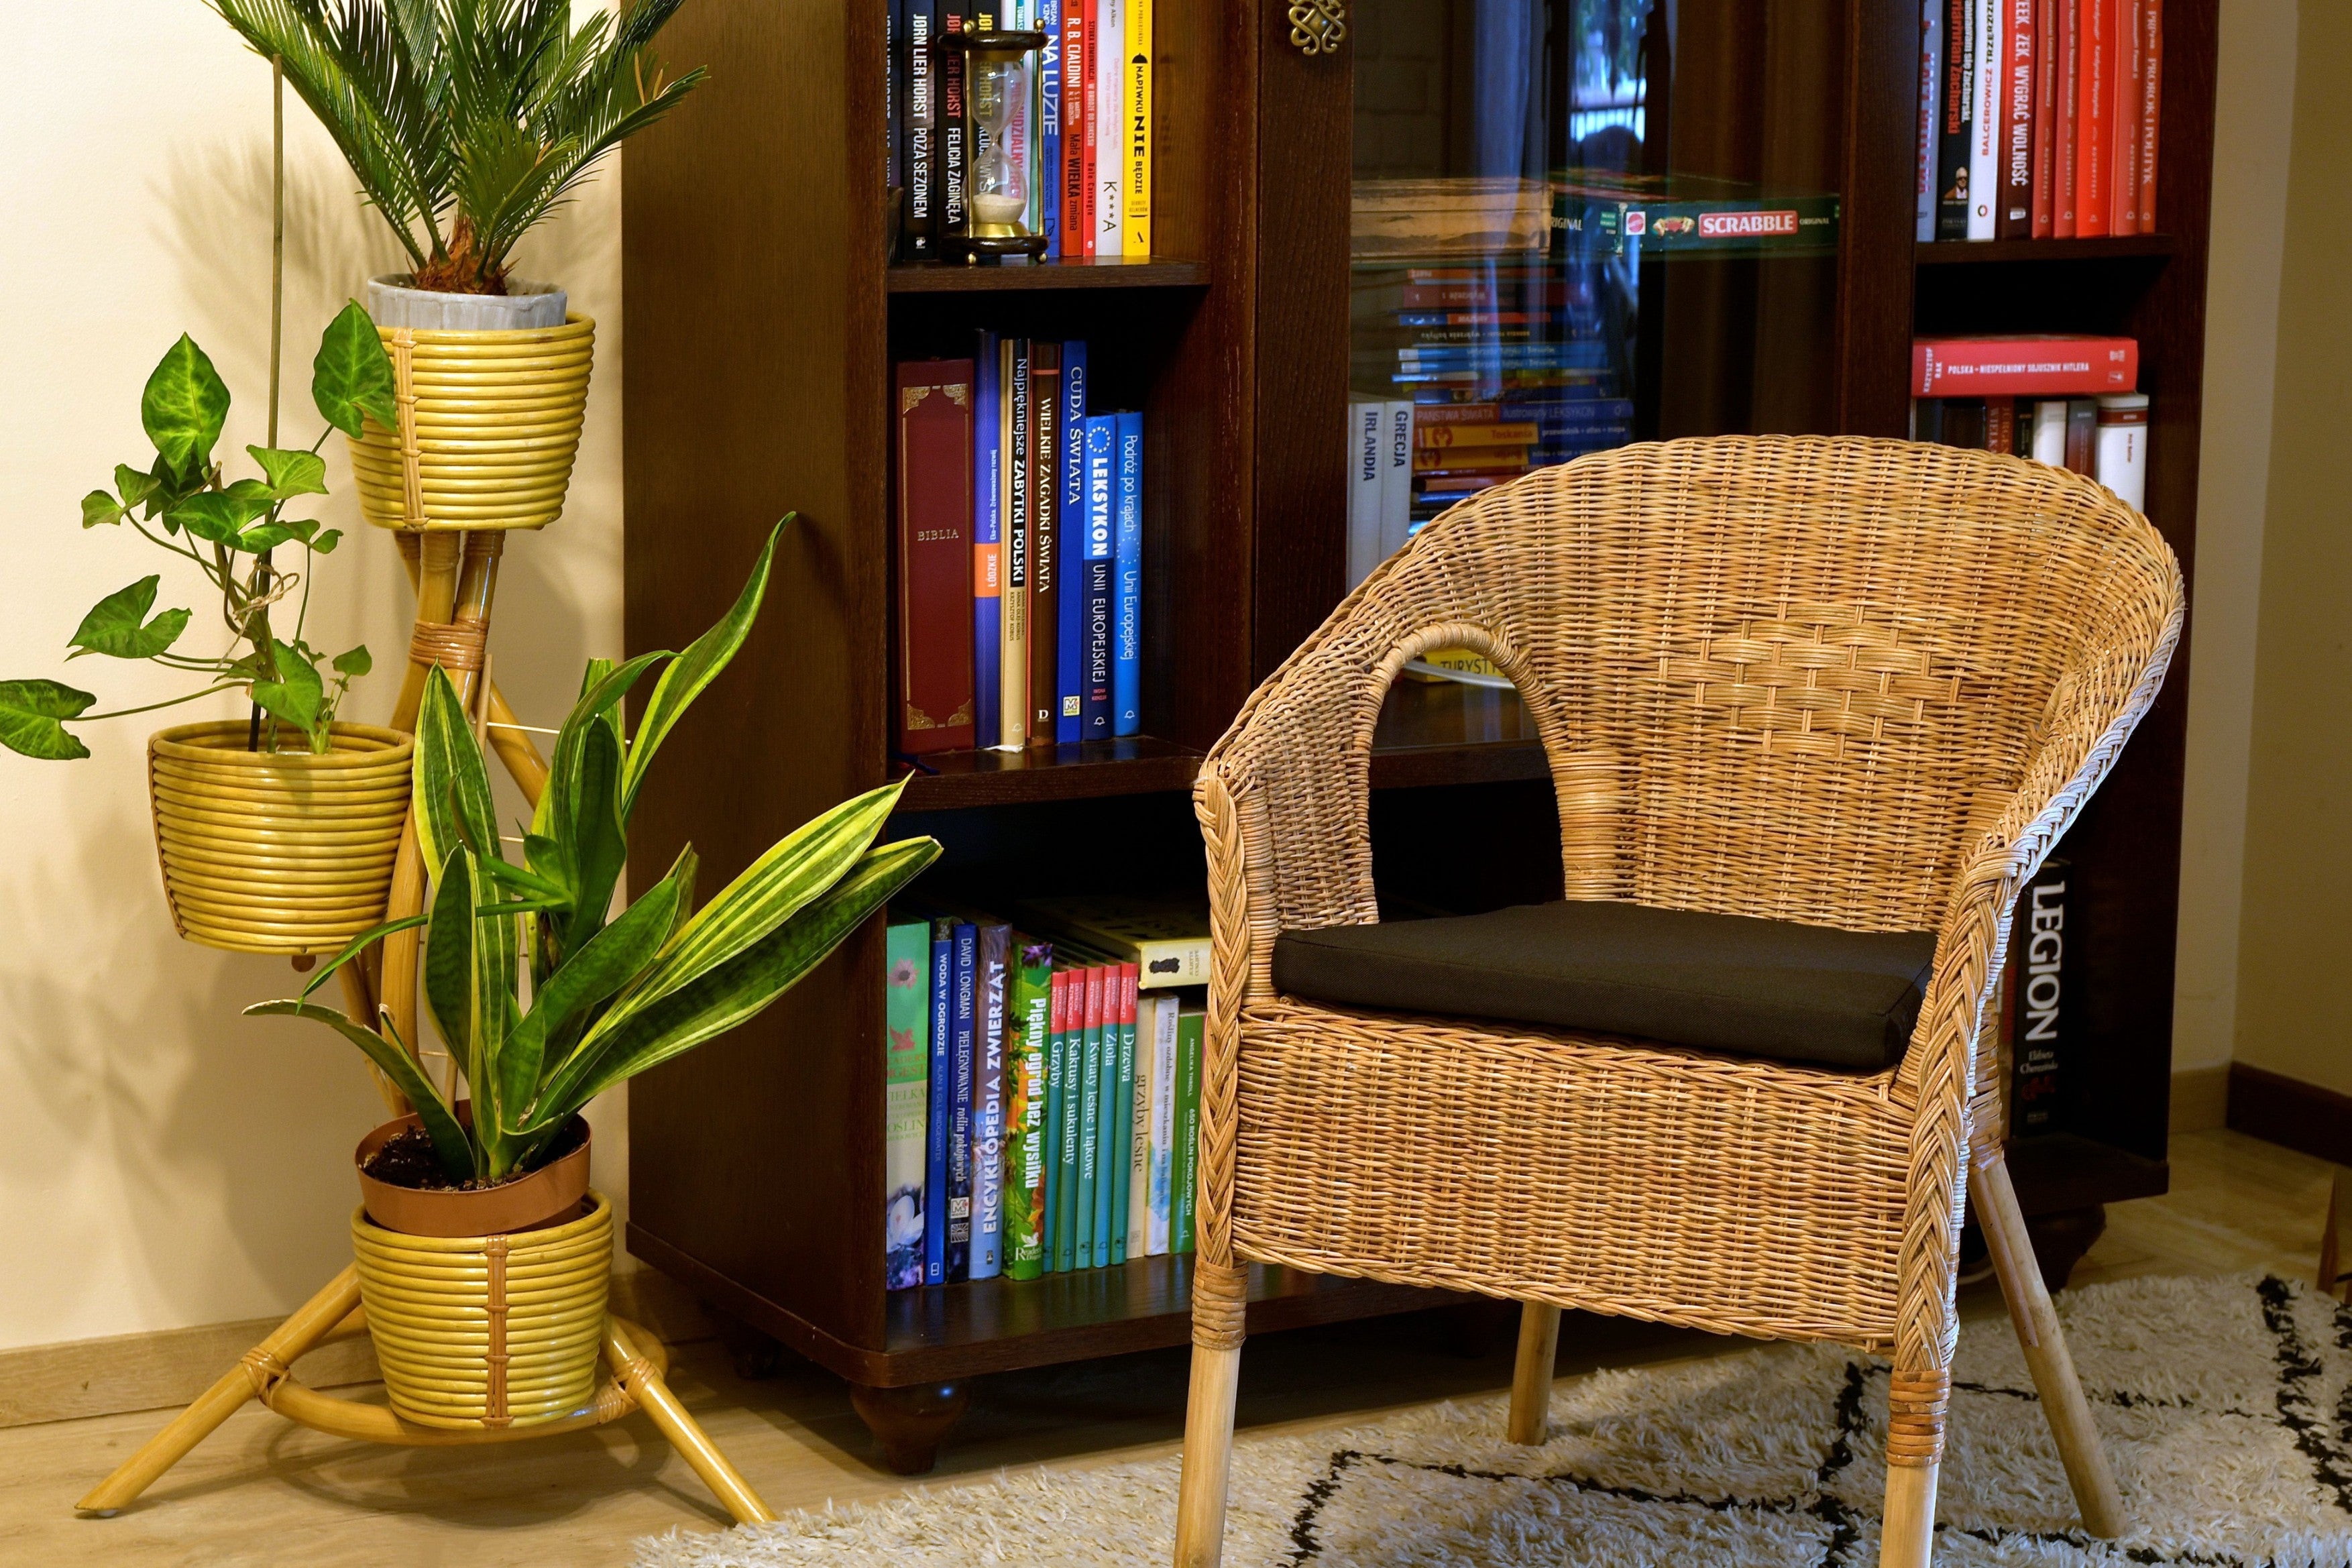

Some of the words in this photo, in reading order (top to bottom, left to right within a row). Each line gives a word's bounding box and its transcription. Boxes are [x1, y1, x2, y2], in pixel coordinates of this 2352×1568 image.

[913, 14, 928, 45] JØRN
[1067, 17, 1081, 28] R.
[1067, 31, 1081, 41] B.
[913, 48, 928, 75] LIER
[1042, 35, 1058, 66] NA
[1067, 44, 1081, 88] CIALDINI
[913, 78, 928, 119] HORST
[947, 78, 961, 118] HORST
[978, 77, 993, 117] HORST
[1042, 70, 1058, 136] LUZIE
[1135, 66, 1143, 113] NAPIWKU
[1948, 66, 1964, 135] Zacharski
[2013, 64, 2031, 120] WYGRAĆ
[2145, 58, 2157, 114] PROROK
[1982, 68, 1993, 156] BALCEROWICZ
[913, 128, 928, 160] POZA
[947, 127, 961, 168] FELICIA
[1069, 134, 1081, 155] Mała
[1134, 115, 1145, 157] NIE
[2011, 123, 2030, 186] WOLNOŚĆ
[2143, 126, 2155, 184] POLITYK
[913, 162, 928, 218] SEZONEM
[945, 170, 962, 223] ZAGINĘŁA
[1068, 158, 1081, 198] WIELKA
[1133, 161, 1143, 194] BĘDZIE
[1067, 200, 1079, 231] zmiana
[1552, 217, 1583, 231] RIGINAL
[1703, 215, 1793, 233] SCRABBLE
[1948, 364, 1974, 375] POLSKA
[2062, 362, 2089, 372] HITLERA
[1013, 358, 1027, 455] Najpiękniejsze
[1070, 366, 1083, 423] CUDA
[1040, 397, 1052, 460] WIELKIE
[1363, 412, 1378, 481] IRLANDIA
[1394, 411, 1408, 468] GRECJA
[1069, 428, 1084, 506] ŚWIATA
[1124, 435, 1138, 473] Podróż
[1013, 459, 1025, 523] ZABYTKI
[1039, 464, 1051, 530] ZAGADKI
[1092, 457, 1108, 556] LEKSYKON
[1120, 478, 1133, 492] po
[917, 528, 959, 541] BIBLIA
[1120, 494, 1138, 533] krajach
[986, 553, 998, 587] ŁÓDZKIE
[1013, 528, 1024, 581] POLSKI
[1038, 535, 1052, 593] ŚWIATA
[1093, 564, 1106, 591] UNII
[1123, 570, 1137, 593] Unii
[1093, 598, 1106, 683] EUROPEJSKIEJ
[1119, 596, 1137, 660] Europejskiej
[938, 953, 948, 988] WODA
[960, 938, 972, 966] DAVID
[2025, 880, 2066, 1042] LEGION
[937, 989, 946, 1001] W
[959, 970, 972, 1019] LONGMAN
[987, 961, 1007, 1070] ZWIERZĄT
[936, 1002, 947, 1056] OGRODZIE
[1025, 997, 1047, 1048] Piękny
[1166, 1011, 1175, 1043] Rośliny
[955, 1030, 970, 1103] PIELĘGNOWANIE
[1048, 1041, 1064, 1088] Grzyby
[1064, 1038, 1081, 1090] Kaktusy
[1085, 1041, 1100, 1086] Kwiaty
[1105, 1033, 1117, 1066] Zioła
[1121, 1033, 1135, 1082] Drzewa
[1164, 1046, 1172, 1081] ozdobne
[1025, 1052, 1045, 1097] ogród
[956, 1107, 969, 1132] roślin
[1026, 1100, 1044, 1127] bez
[1086, 1090, 1098, 1123] leśne
[1133, 1074, 1150, 1127] grzyby
[983, 1075, 1001, 1234] ENCYKLOPEDIA
[1062, 1103, 1078, 1165] sukulenty
[1133, 1131, 1149, 1172] leśne
[1187, 1125, 1196, 1156] ROŚLIN
[952, 1133, 968, 1182] pokojowych
[1023, 1131, 1042, 1188] wysiłku
[1083, 1135, 1097, 1179] łąkowe
[1185, 1157, 1194, 1216] POKOJOWYCH
